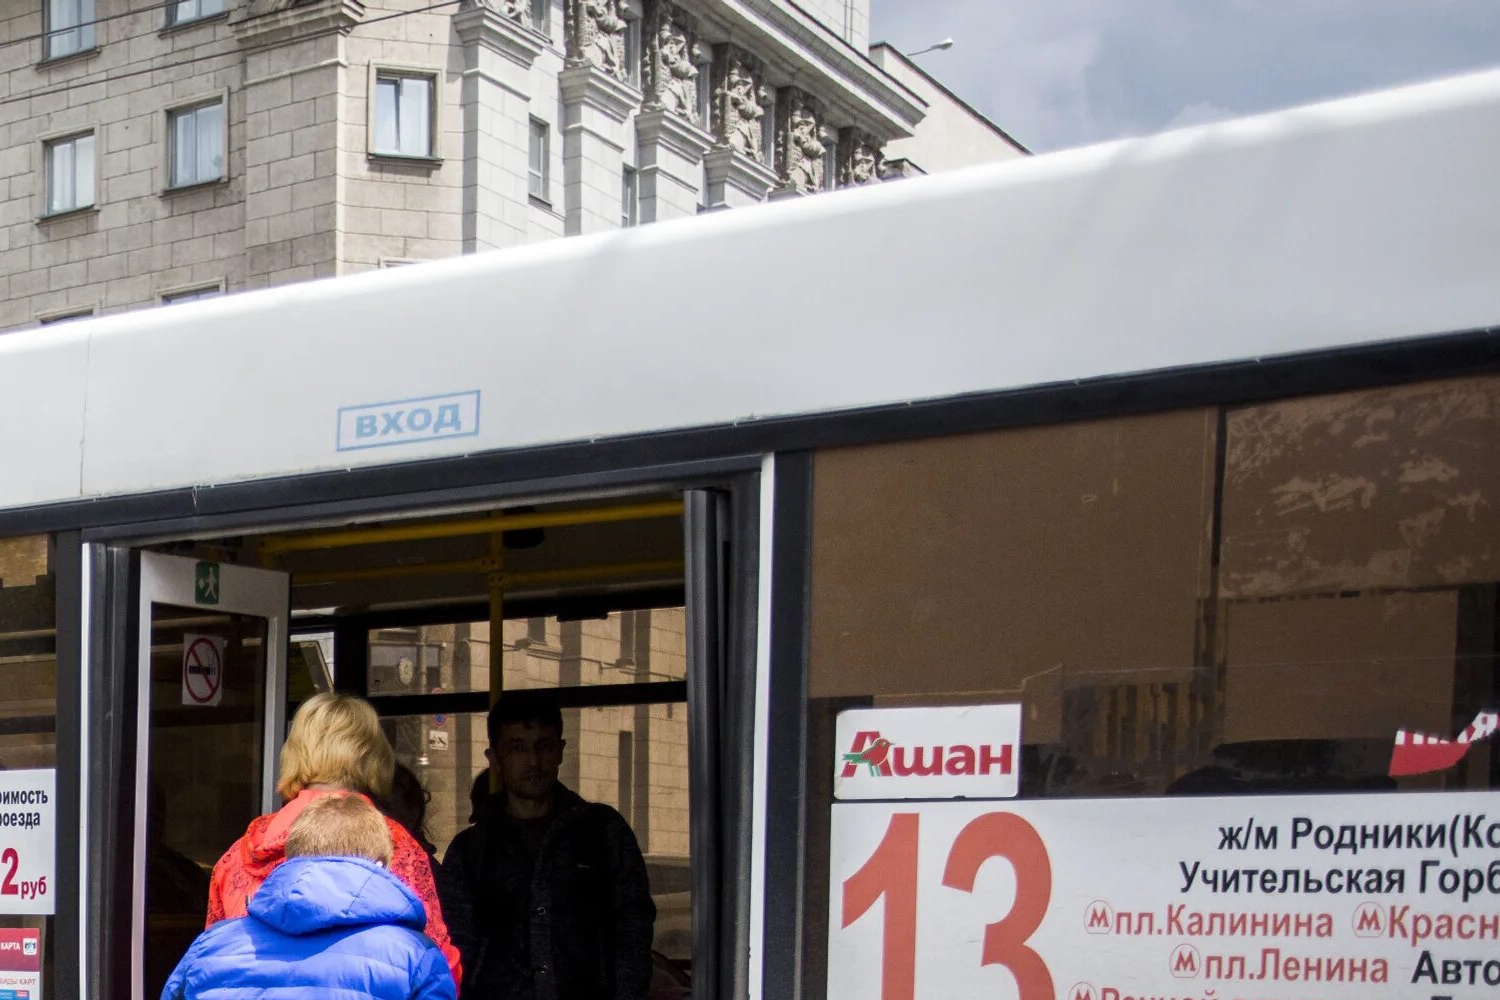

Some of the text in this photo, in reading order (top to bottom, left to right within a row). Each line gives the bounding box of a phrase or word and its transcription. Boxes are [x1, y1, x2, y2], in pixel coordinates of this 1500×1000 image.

[355, 403, 461, 439] ВХОД
[841, 731, 1012, 777] Ашан
[1217, 817, 1278, 851] ж/м
[1178, 860, 1500, 903] Учительская Горб
[1115, 903, 1333, 938] пл.Калинина
[1389, 905, 1500, 946] Красн
[0, 942, 21, 951] КАРТА
[1204, 948, 1389, 984] пл.Ленина
[1411, 950, 1500, 986] Авто
